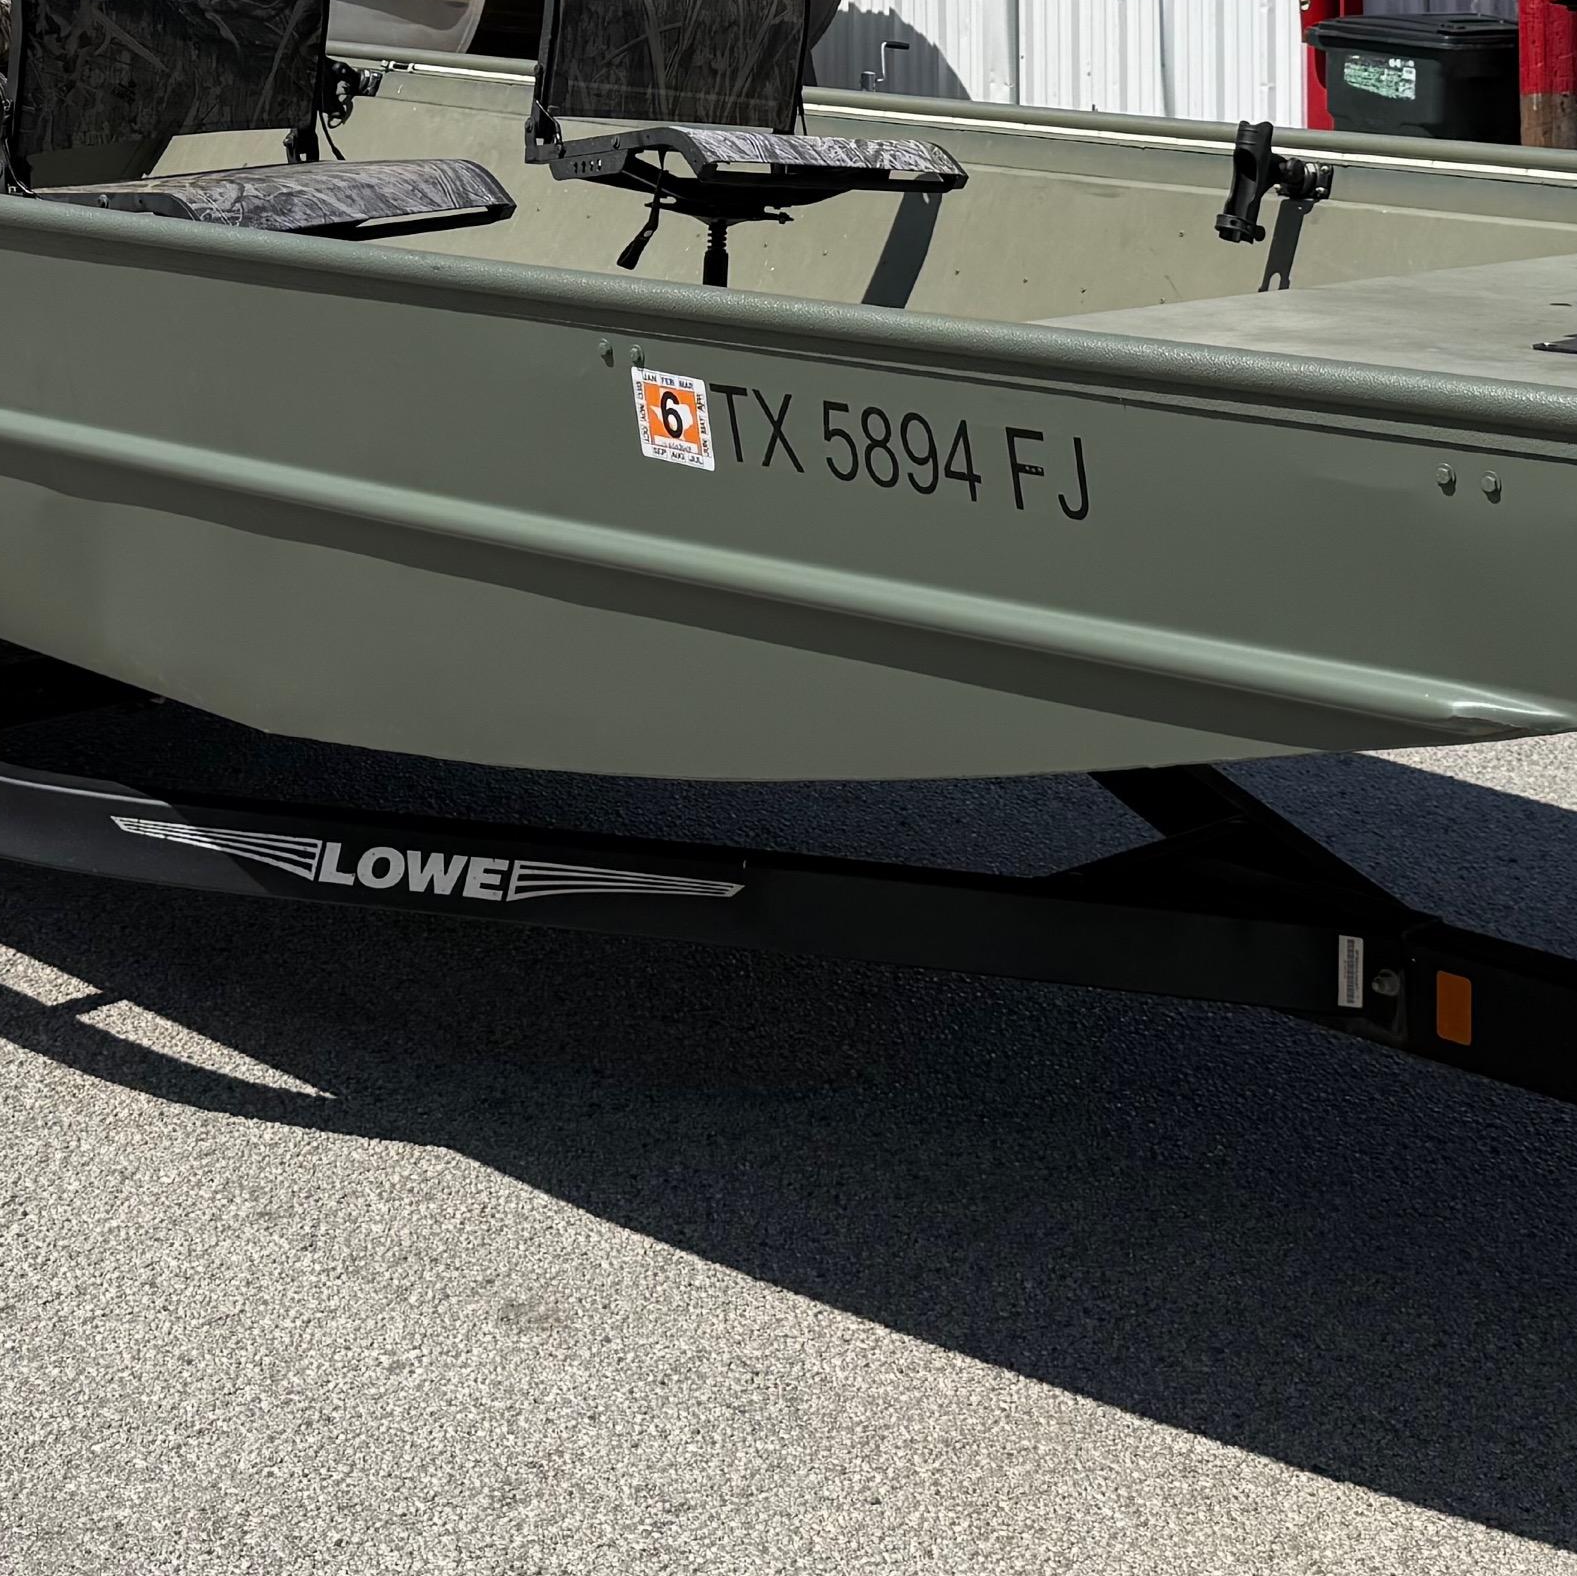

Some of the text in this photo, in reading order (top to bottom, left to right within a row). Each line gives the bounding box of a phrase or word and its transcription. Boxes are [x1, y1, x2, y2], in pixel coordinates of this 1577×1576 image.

[660, 390, 684, 440] 6
[709, 383, 1090, 521] TX 5894 FJ
[318, 841, 509, 901] LOWE
